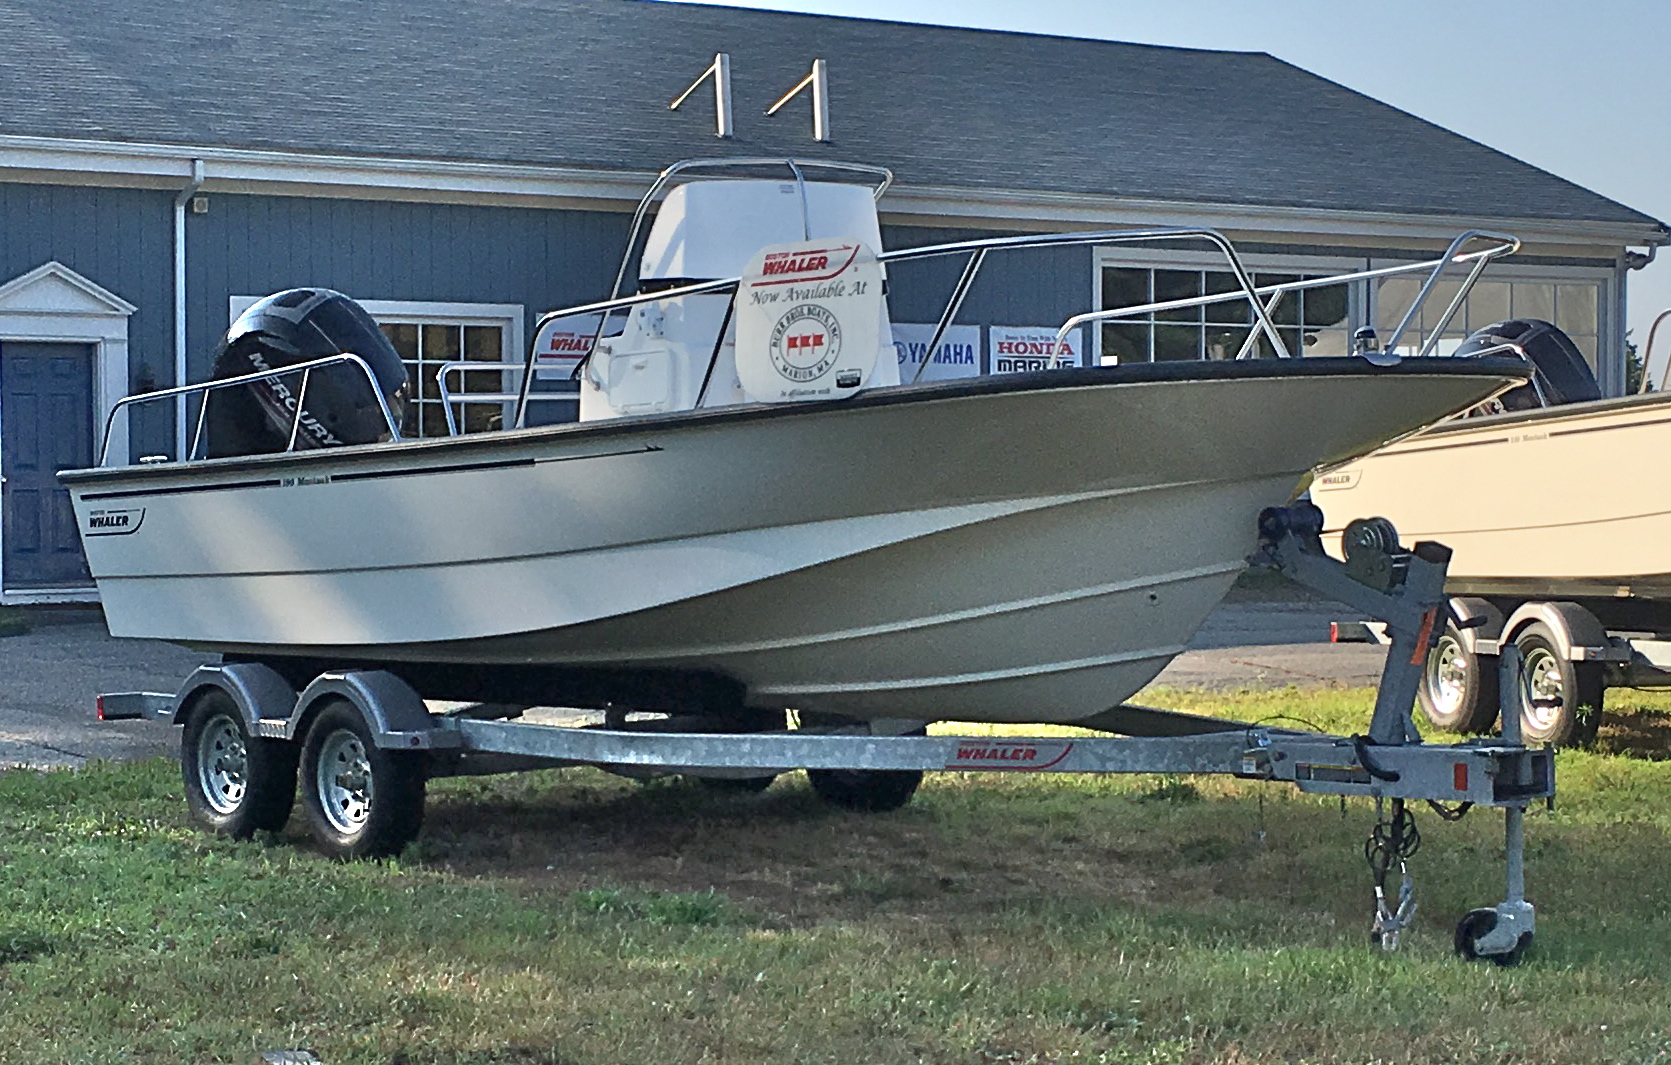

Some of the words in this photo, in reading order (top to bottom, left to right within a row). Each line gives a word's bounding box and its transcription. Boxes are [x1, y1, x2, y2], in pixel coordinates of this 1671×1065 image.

[762, 256, 828, 275] WHALER
[749, 291, 779, 305] Now
[781, 280, 846, 302] Available
[848, 281, 867, 296] At
[550, 338, 591, 350] WHAL
[248, 352, 343, 445] MERCURY
[89, 515, 129, 528] WHALER
[957, 749, 1037, 760] WHALER
